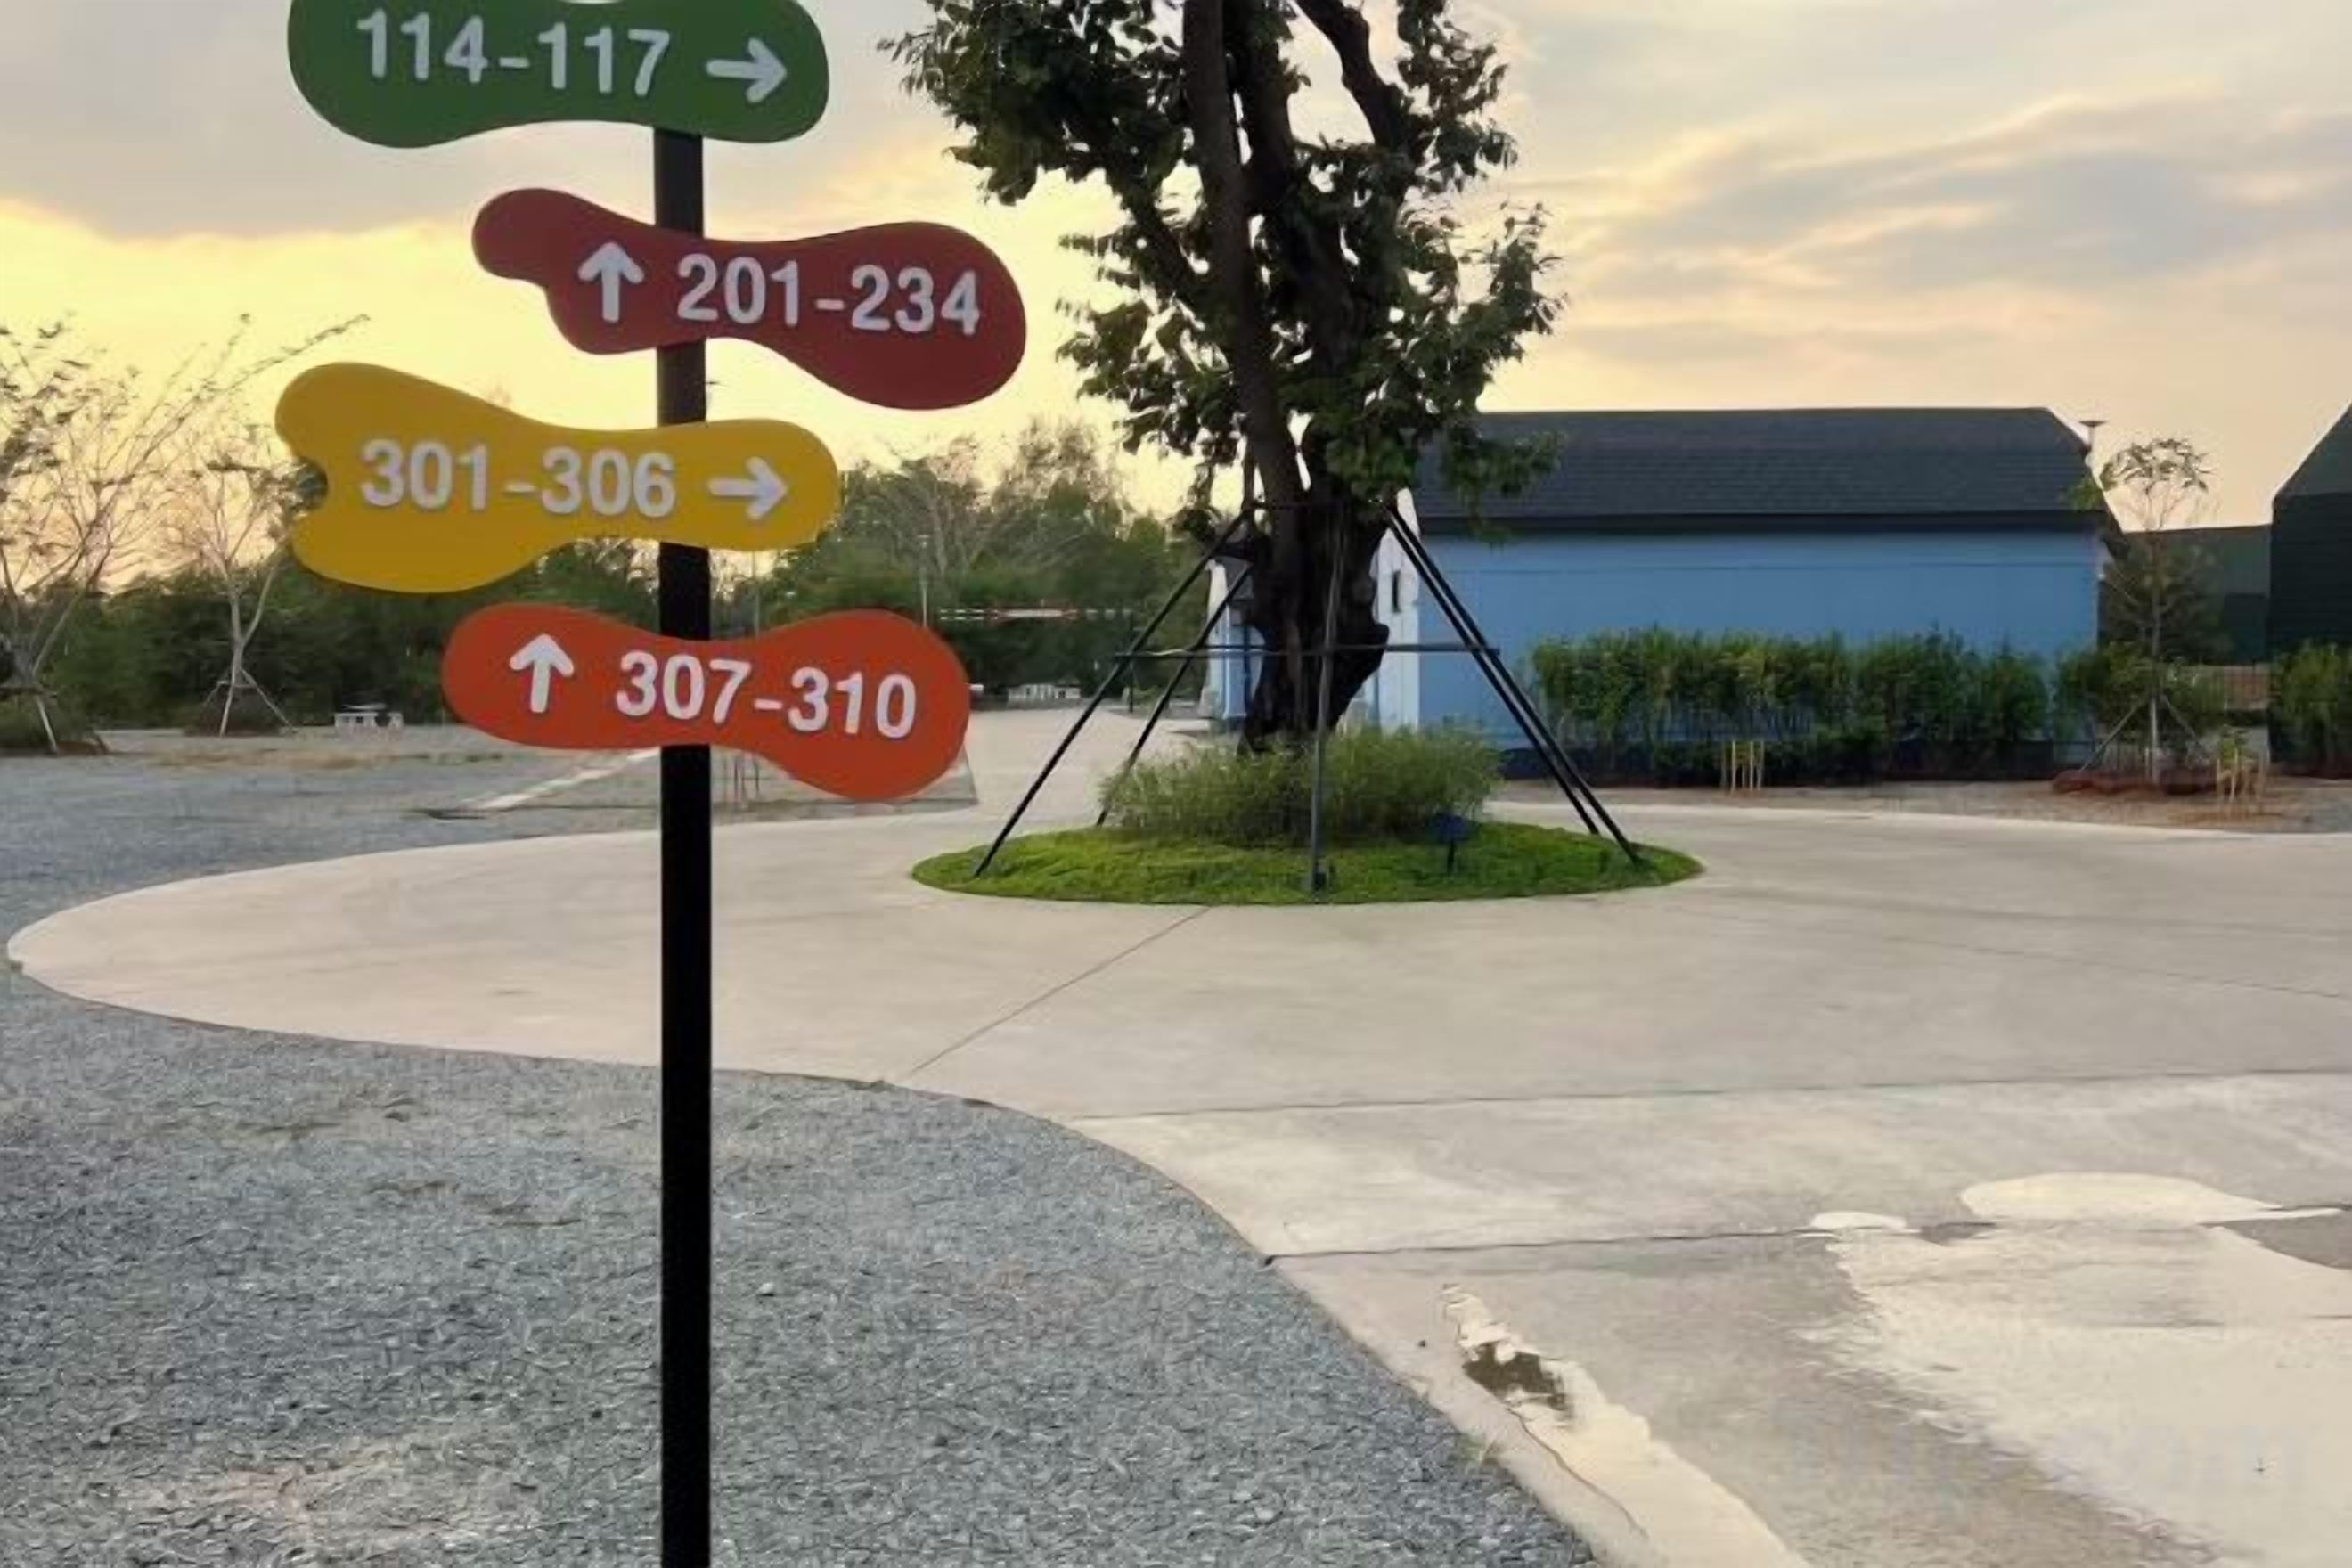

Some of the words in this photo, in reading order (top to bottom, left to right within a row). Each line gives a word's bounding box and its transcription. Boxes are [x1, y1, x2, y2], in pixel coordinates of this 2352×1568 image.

[357, 10, 671, 96] 114-117
[677, 253, 981, 336] 201-234
[362, 440, 676, 518] 301-306
[615, 650, 917, 739] 307-310
